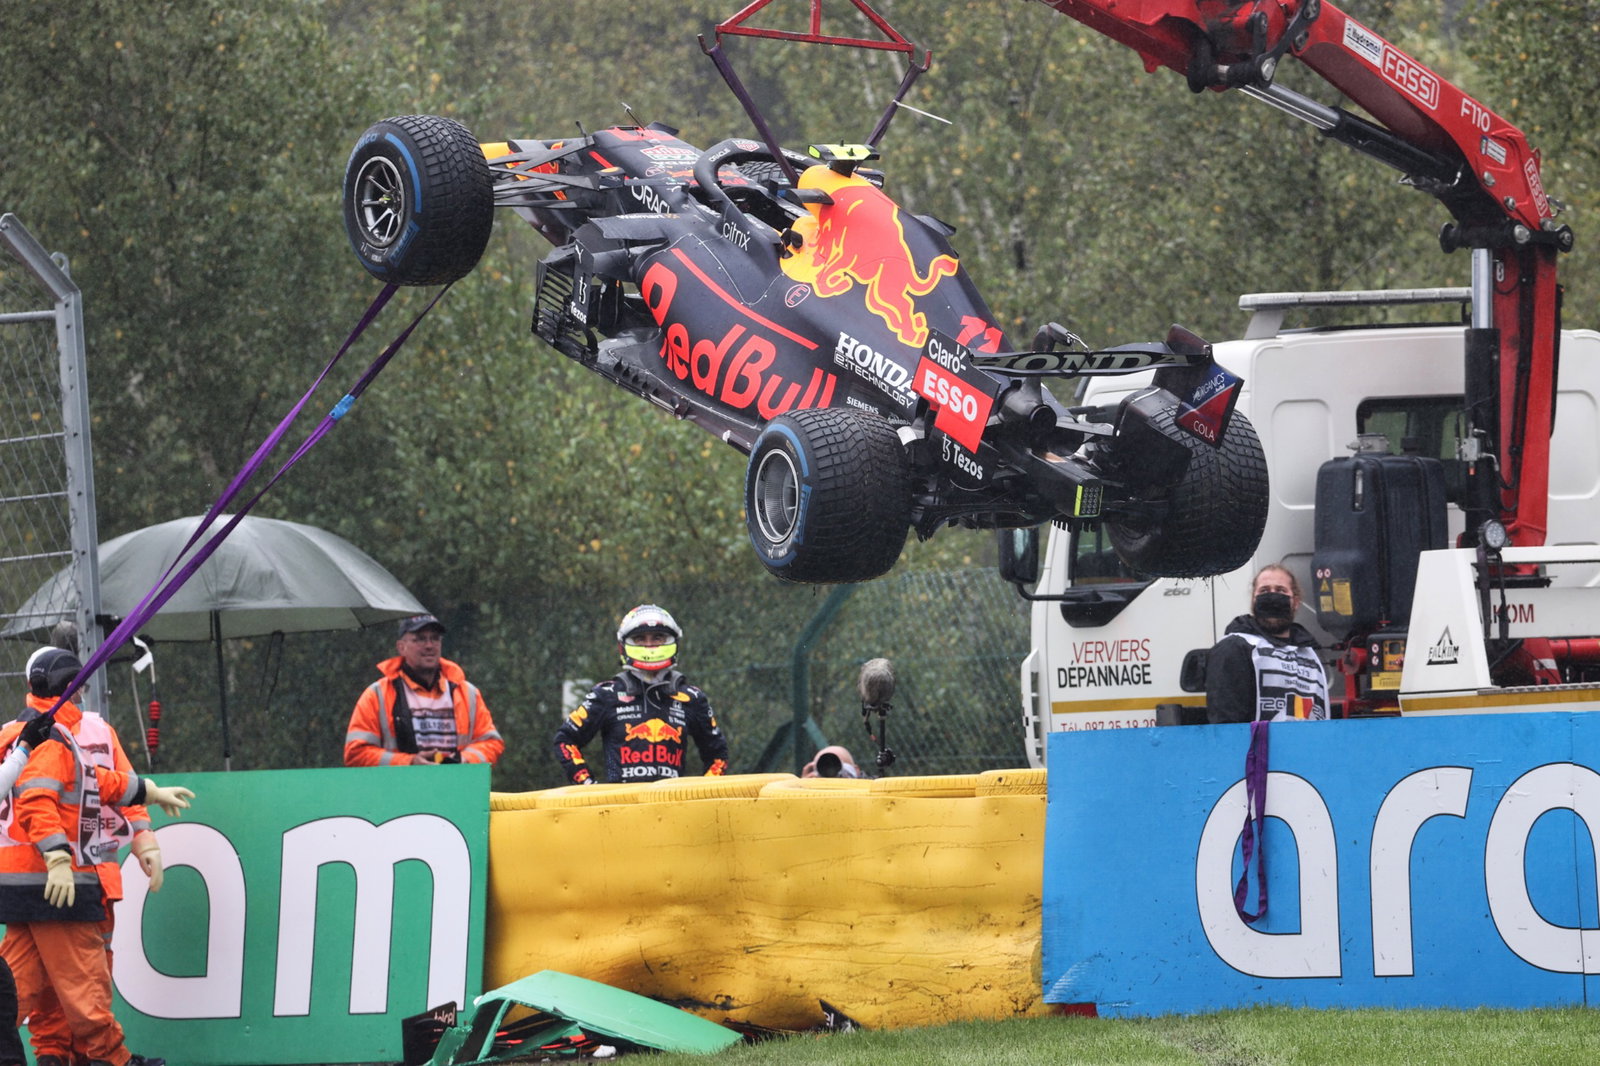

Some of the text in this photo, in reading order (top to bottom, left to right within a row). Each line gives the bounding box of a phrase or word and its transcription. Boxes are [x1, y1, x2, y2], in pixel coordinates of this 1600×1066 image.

[1384, 52, 1436, 108] FASSI
[1460, 98, 1490, 132] F110
[1526, 162, 1547, 212] FASSI
[723, 222, 751, 252] citrix
[836, 332, 918, 399] HONDA
[928, 338, 961, 374] Claro
[972, 352, 1190, 372] HONDA
[846, 396, 879, 415] SIEMENS
[923, 369, 978, 422] ESSO
[1193, 420, 1215, 442] COLA
[953, 443, 983, 481] Tezos
[1073, 638, 1151, 664] VERVIERS
[1057, 660, 1152, 689] DÉPANNAGE
[621, 744, 683, 766] Red Bull
[621, 765, 679, 778] HONDA
